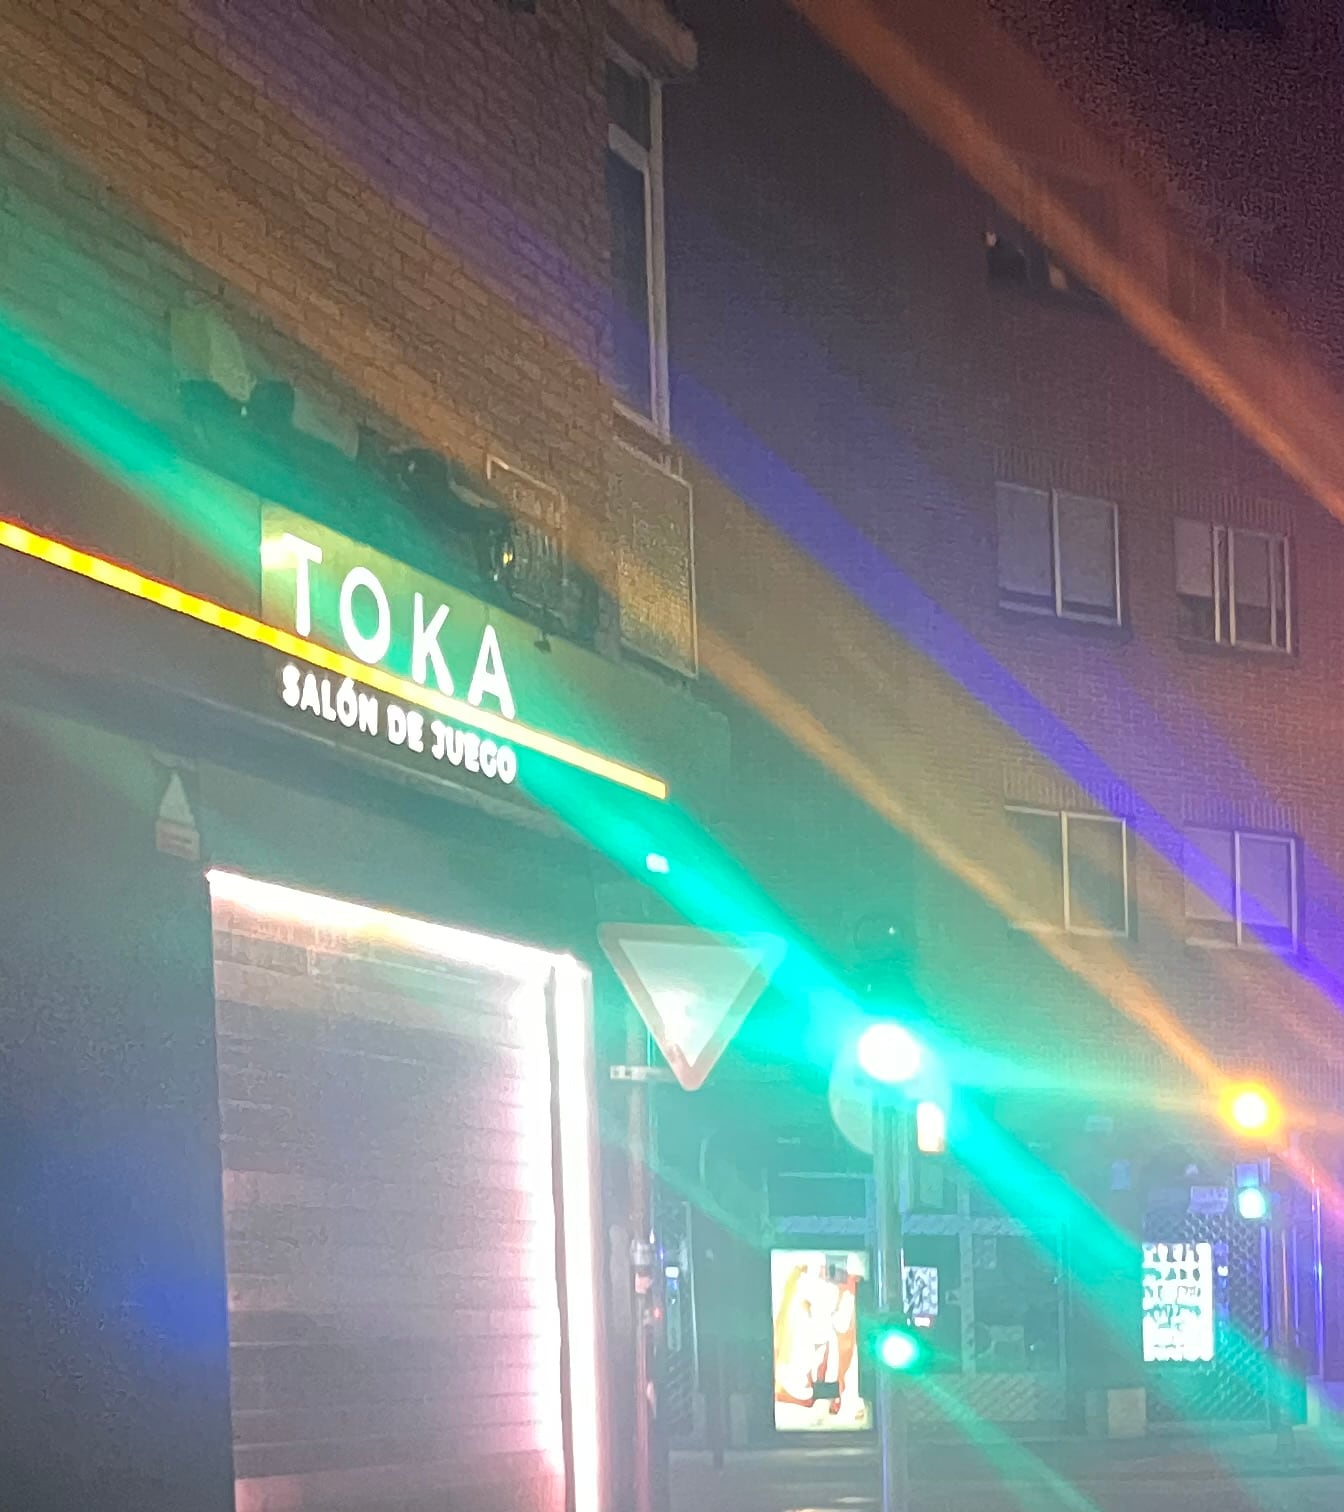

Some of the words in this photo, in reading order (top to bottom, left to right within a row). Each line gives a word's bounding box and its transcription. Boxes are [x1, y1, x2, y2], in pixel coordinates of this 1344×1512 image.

[282, 532, 516, 721] TOKA
[281, 664, 379, 736] SALÓN
[386, 703, 424, 753] DE
[430, 719, 517, 784] JUEGO
